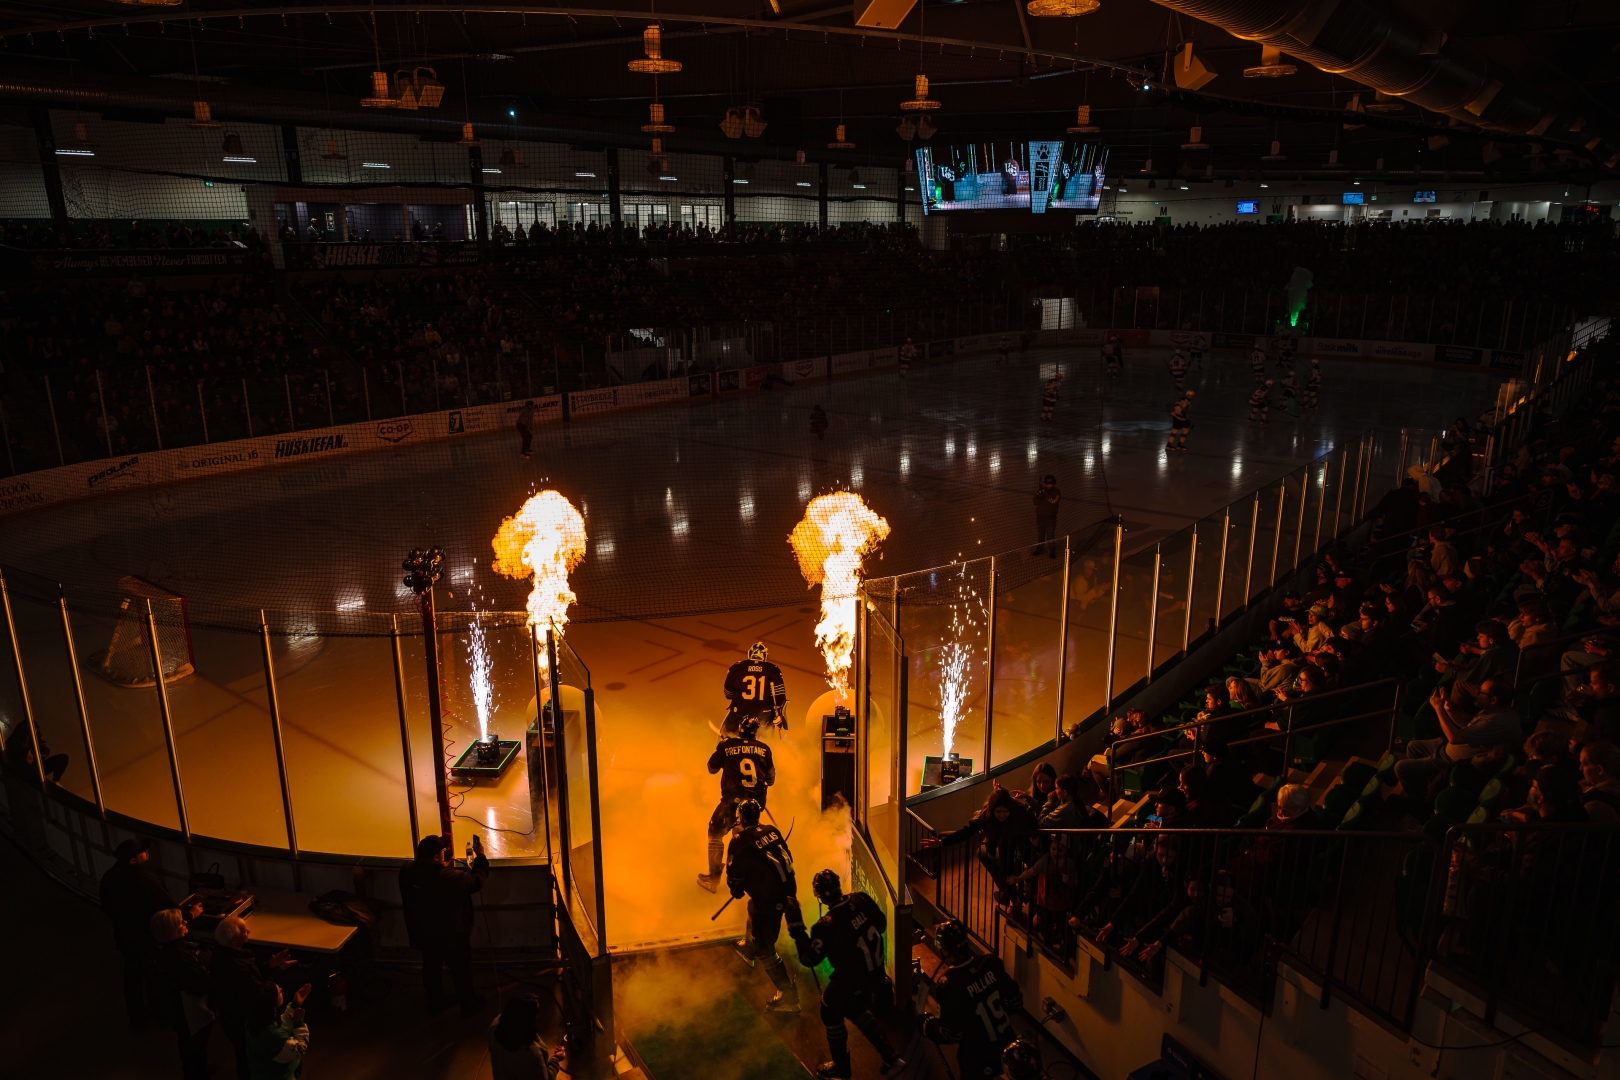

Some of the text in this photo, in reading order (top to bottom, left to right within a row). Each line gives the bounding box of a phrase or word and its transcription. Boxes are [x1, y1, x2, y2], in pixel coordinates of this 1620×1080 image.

[1159, 206, 1168, 216] M
[1272, 204, 1282, 215] W
[53, 256, 98, 272] Always
[99, 254, 153, 268] REMEMBERED
[153, 255, 186, 266] Never
[186, 254, 228, 266] FORGOTTEN
[534, 401, 559, 410] ALBERT
[576, 392, 613, 404] STAYBRIDGE
[380, 424, 410, 435] CO-OP
[192, 450, 259, 469] ORIGINAL 16
[88, 456, 139, 489] PROLINE
[747, 665, 763, 673] ROSS
[741, 675, 766, 701] 31
[739, 758, 758, 788] 9
[850, 911, 868, 930] BALL
[856, 925, 884, 972] 12
[966, 970, 997, 998] PILLAR
[975, 989, 1010, 1042] 19
